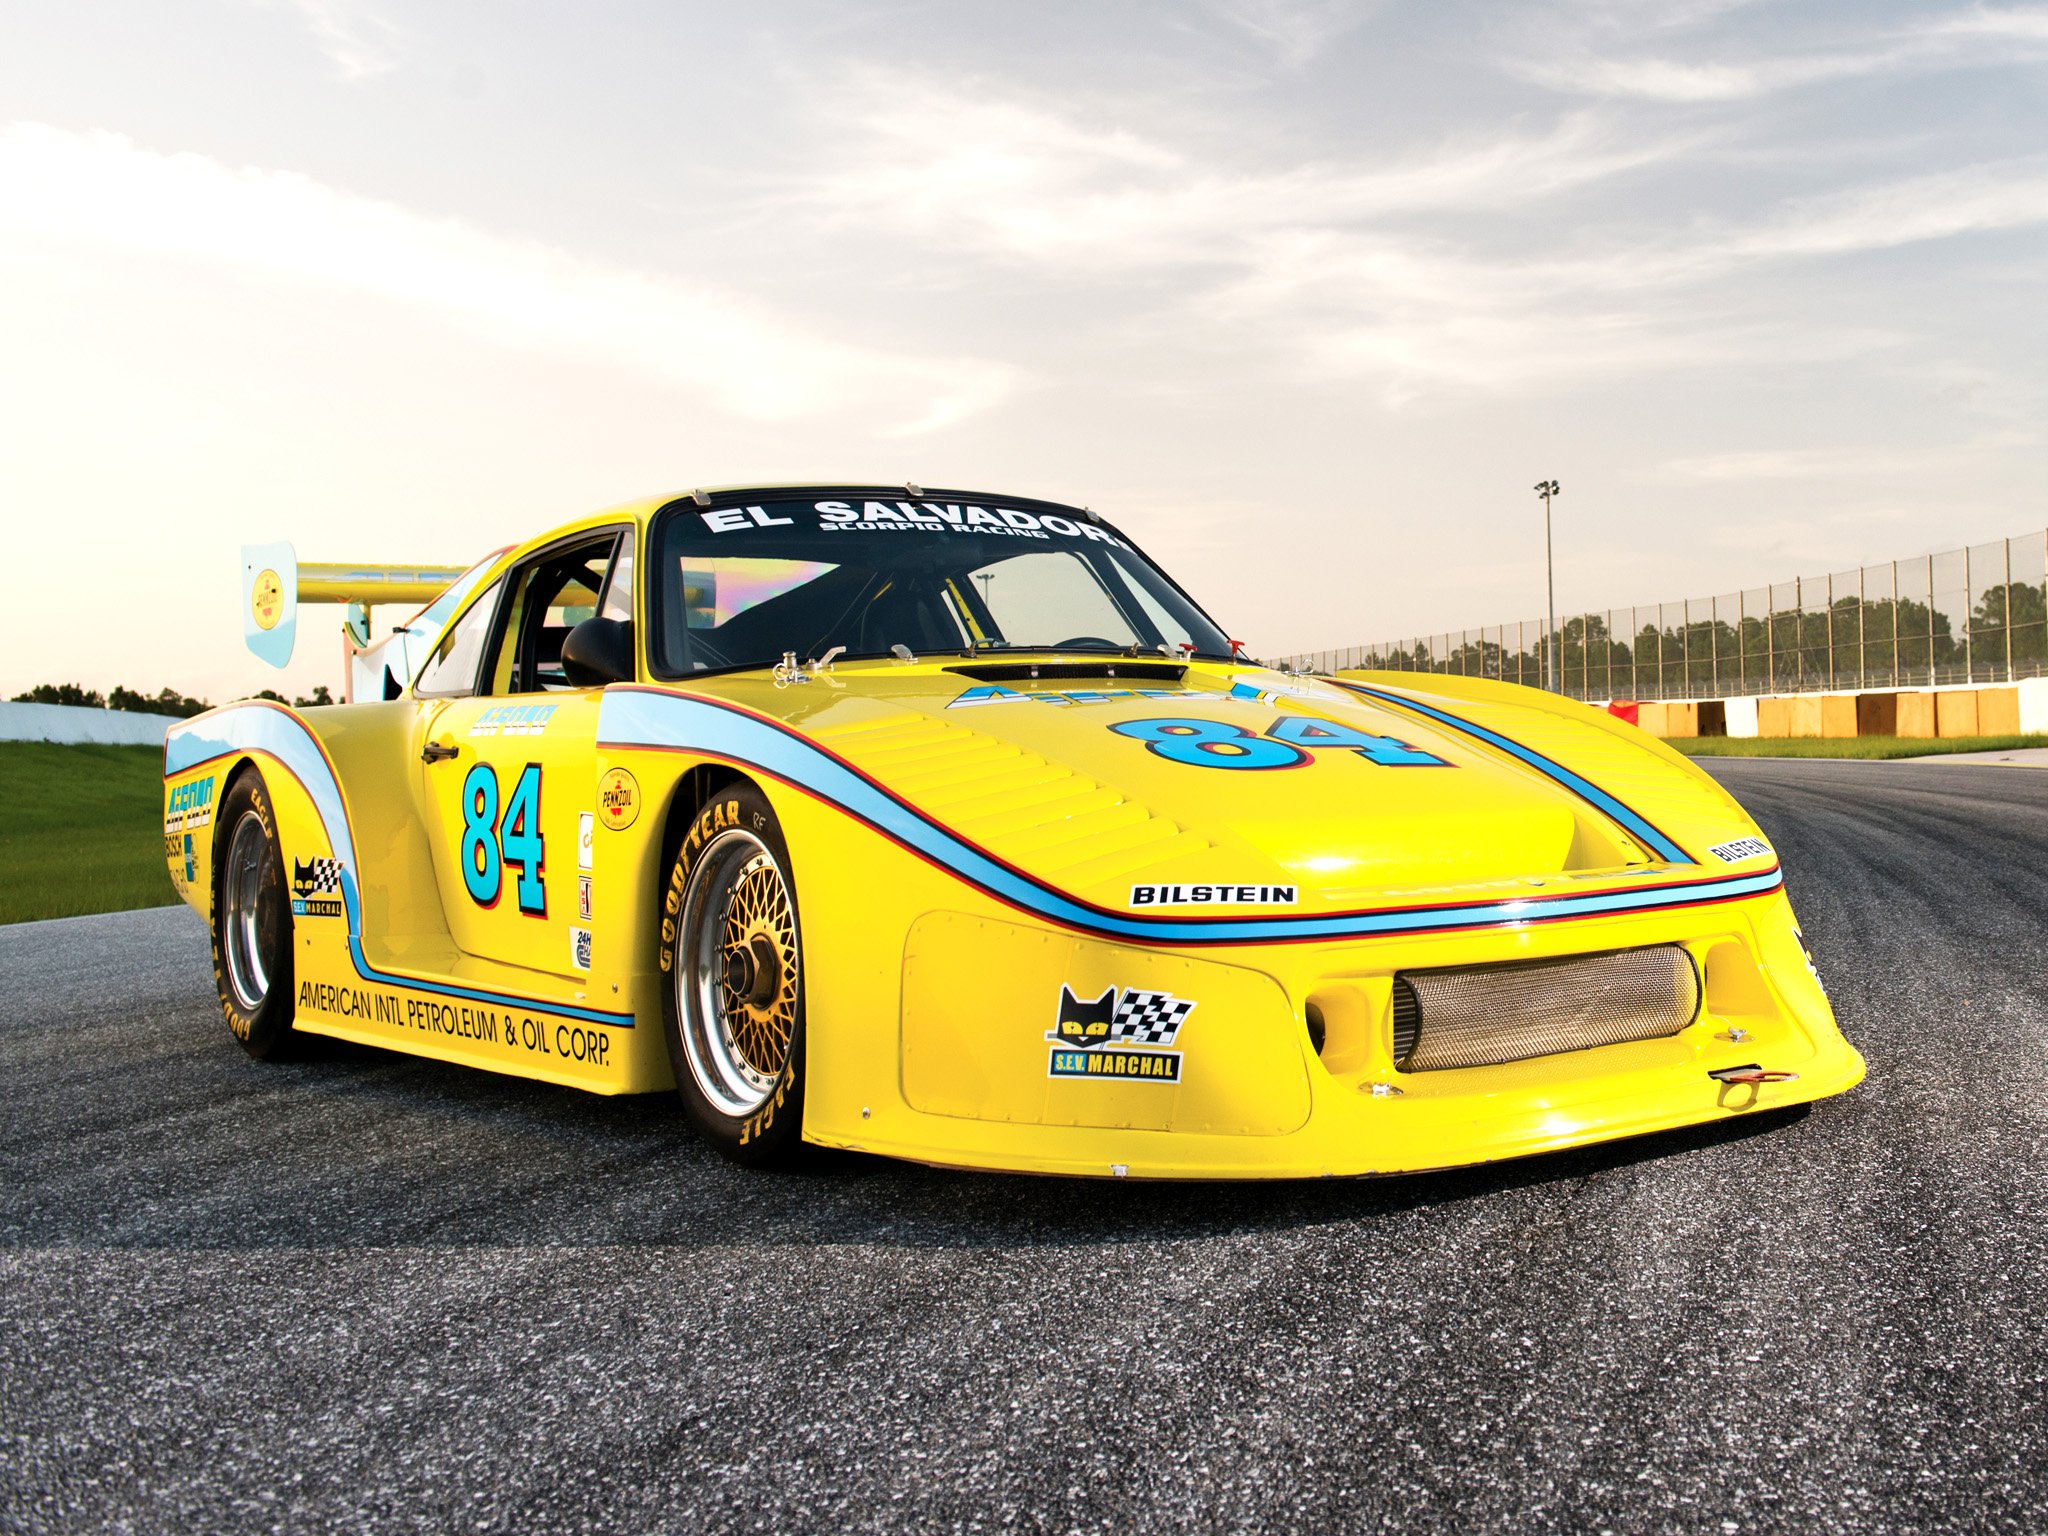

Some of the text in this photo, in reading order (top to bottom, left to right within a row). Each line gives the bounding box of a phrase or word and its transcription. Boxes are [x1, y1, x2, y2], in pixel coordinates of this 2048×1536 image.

[700, 501, 1119, 548] EL SALVADOR
[819, 521, 1050, 539] SCORPIO RACING
[1106, 716, 1460, 771] 84
[603, 789, 632, 807] PENNZOIL
[462, 762, 547, 919] 84
[1709, 838, 1772, 863] BILSTEIN
[660, 800, 741, 972] GOODYEAR
[1132, 885, 1294, 905] BILSTEIN
[306, 902, 341, 915] MARCHAL
[299, 981, 371, 1020] AMERICAN
[407, 999, 498, 1043] PETROLEUM
[505, 1015, 518, 1046] &
[522, 1018, 550, 1053] OIL
[556, 1025, 609, 1066] CORP.
[1055, 1053, 1173, 1077] S.E.V. MARCHAL
